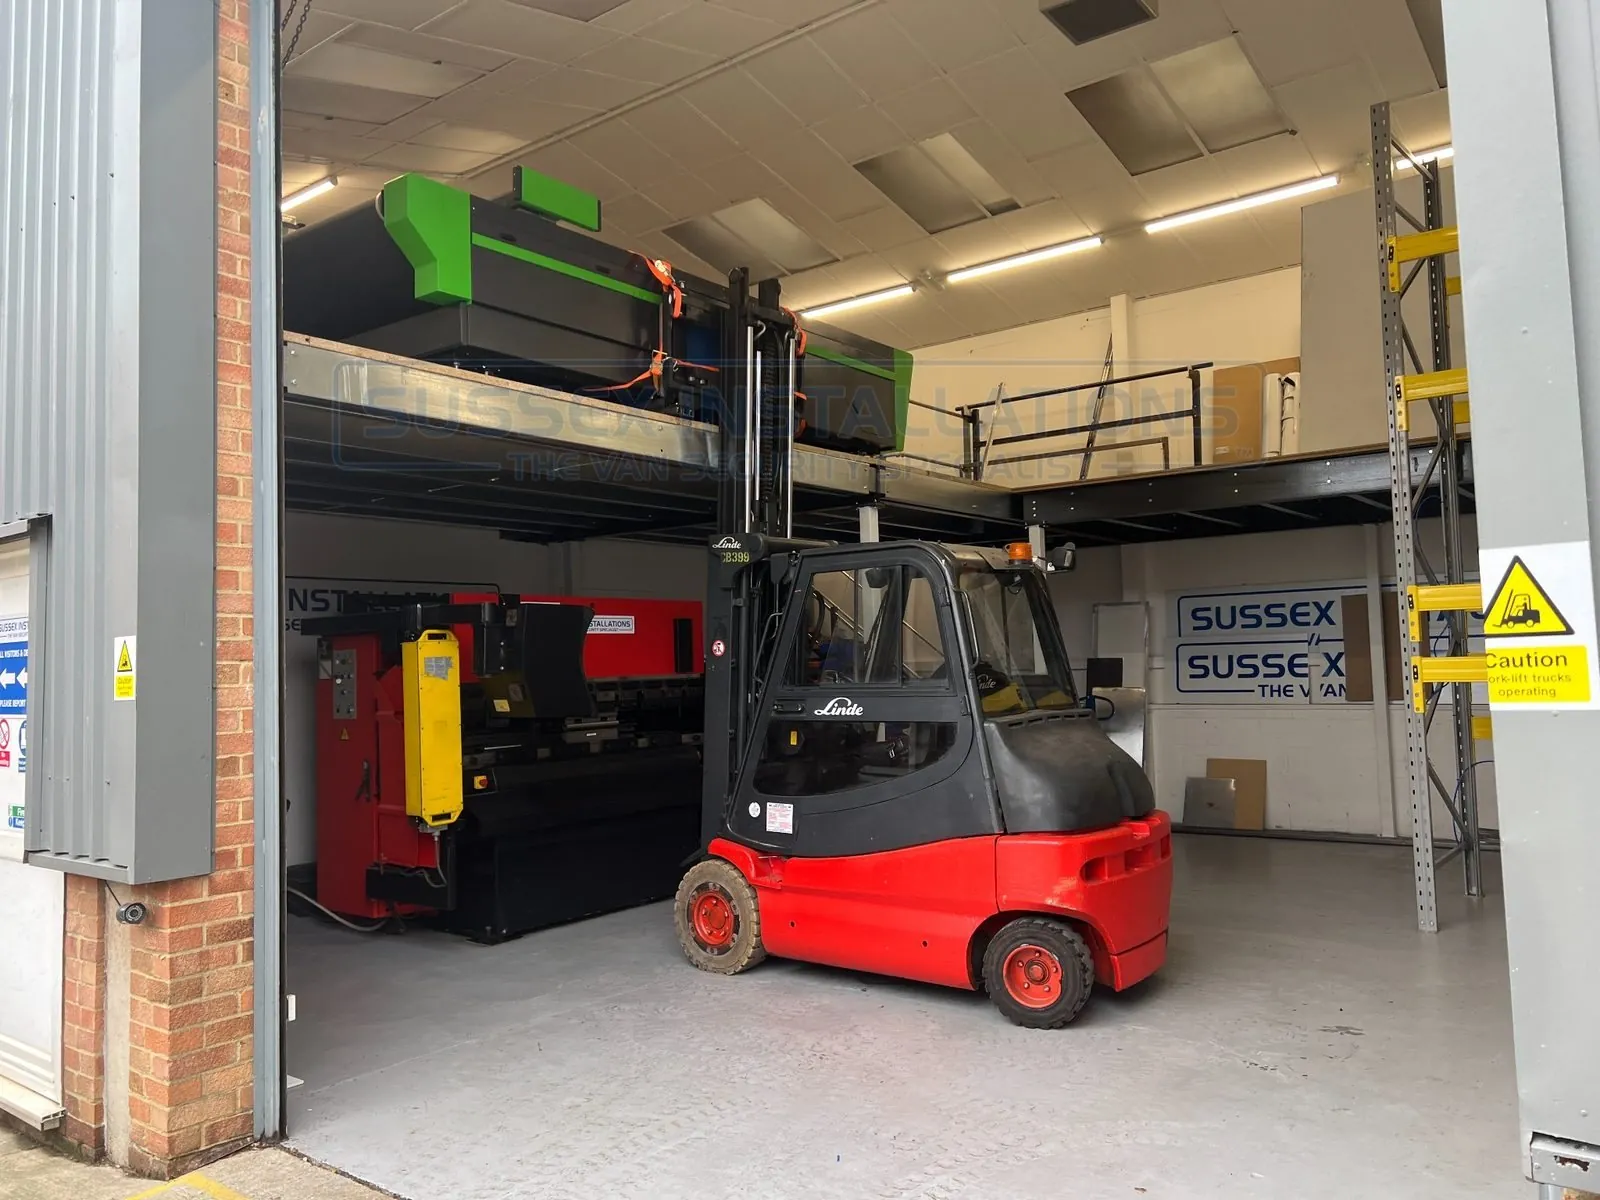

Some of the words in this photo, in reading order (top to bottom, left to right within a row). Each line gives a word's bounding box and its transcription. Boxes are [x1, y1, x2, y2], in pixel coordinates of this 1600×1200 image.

[712, 536, 742, 549] Linde
[1190, 600, 1337, 631] SUSSEX
[1532, 672, 1572, 684] trucks
[1257, 684, 1294, 698] THE
[1497, 685, 1557, 698] operating
[814, 696, 864, 716] Linde
